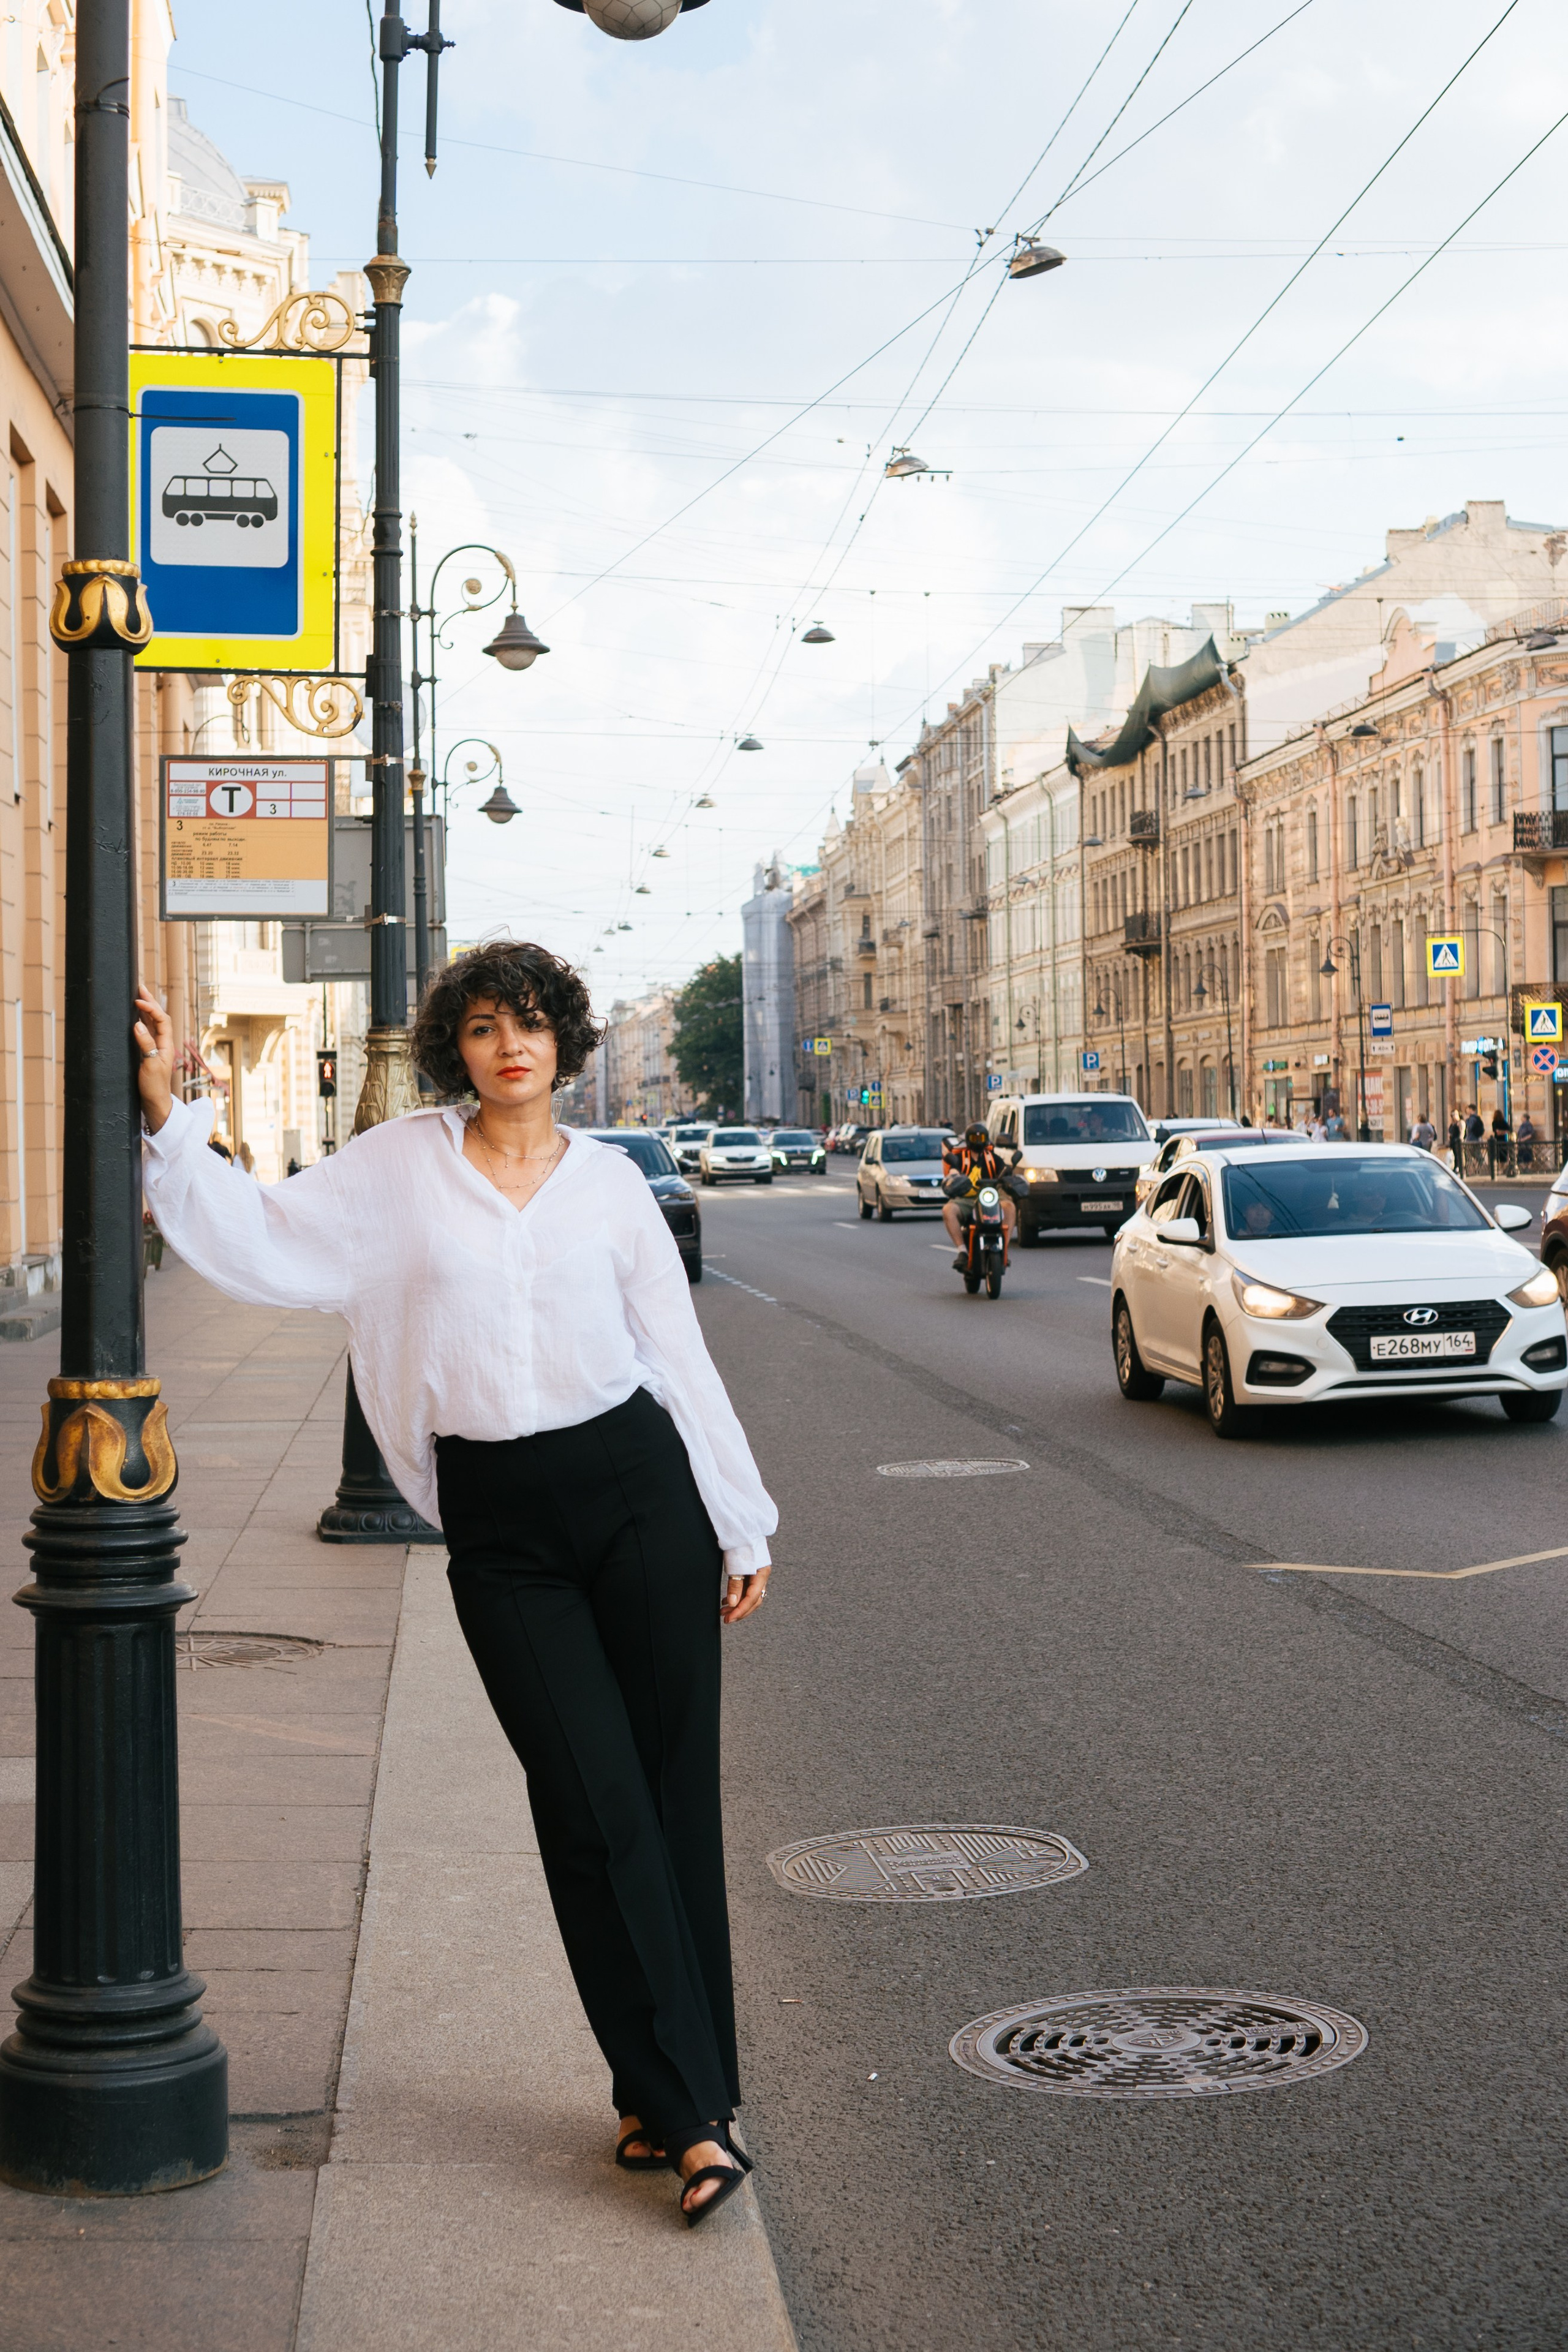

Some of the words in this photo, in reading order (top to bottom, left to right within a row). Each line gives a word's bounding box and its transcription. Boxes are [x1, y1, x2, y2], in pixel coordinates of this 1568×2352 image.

[209, 768, 269, 777] КИРОЧНАЯ
[272, 769, 287, 778] ул.
[222, 786, 241, 813] Т
[270, 804, 277, 815] 3
[176, 820, 183, 831] 3
[1377, 1338, 1441, 1356] Е268МУ
[1446, 1335, 1470, 1348] 164
